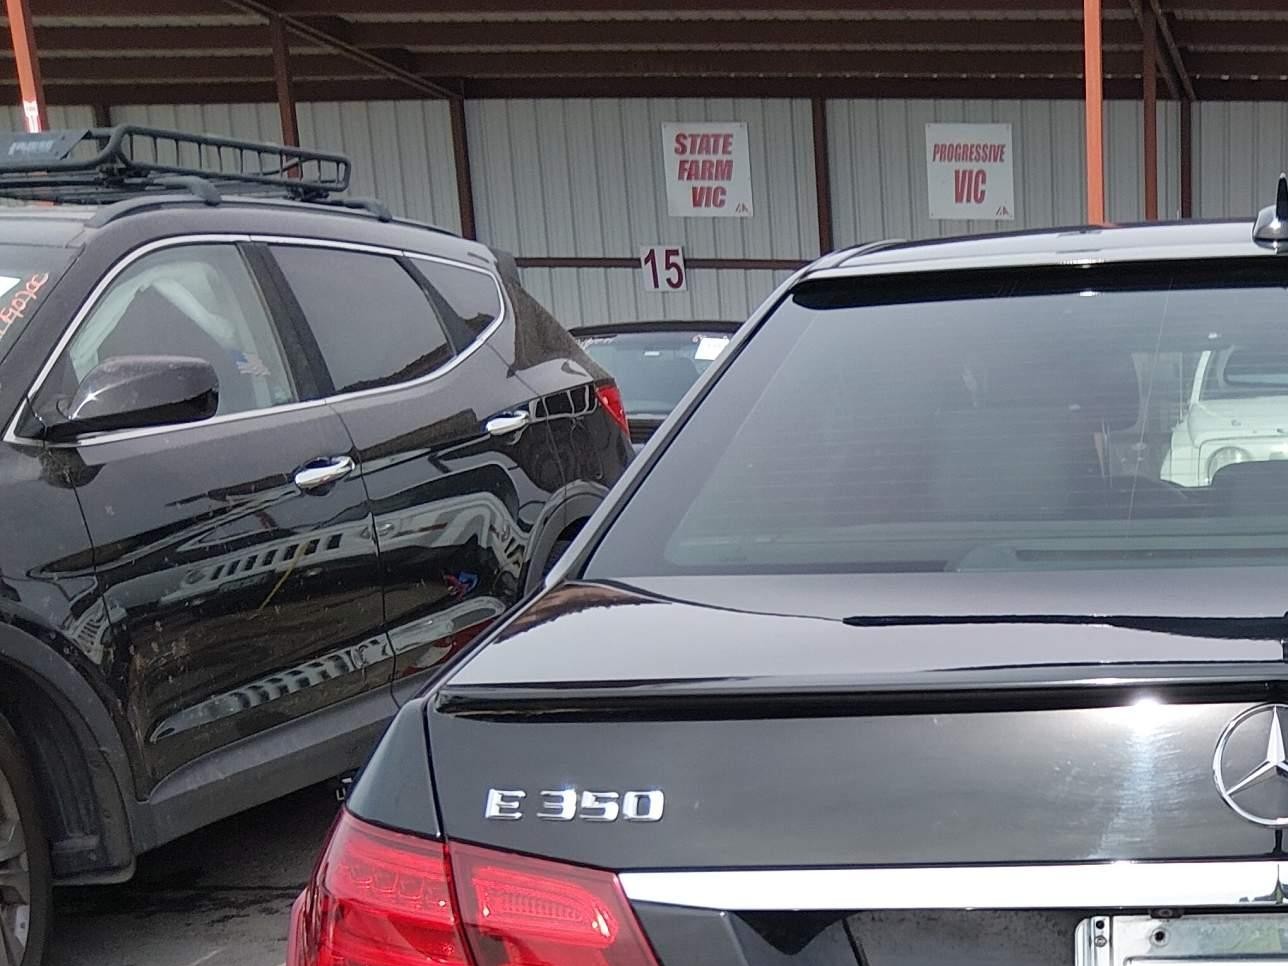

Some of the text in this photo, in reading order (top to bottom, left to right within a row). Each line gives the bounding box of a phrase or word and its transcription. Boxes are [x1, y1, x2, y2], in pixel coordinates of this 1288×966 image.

[674, 132, 734, 156] STATE
[932, 143, 1006, 163] PROGRESSIVE
[677, 159, 734, 181] FARM
[691, 186, 727, 209] VIC
[954, 169, 987, 204] VIC
[644, 248, 684, 289] 15
[485, 788, 665, 822] E 350
